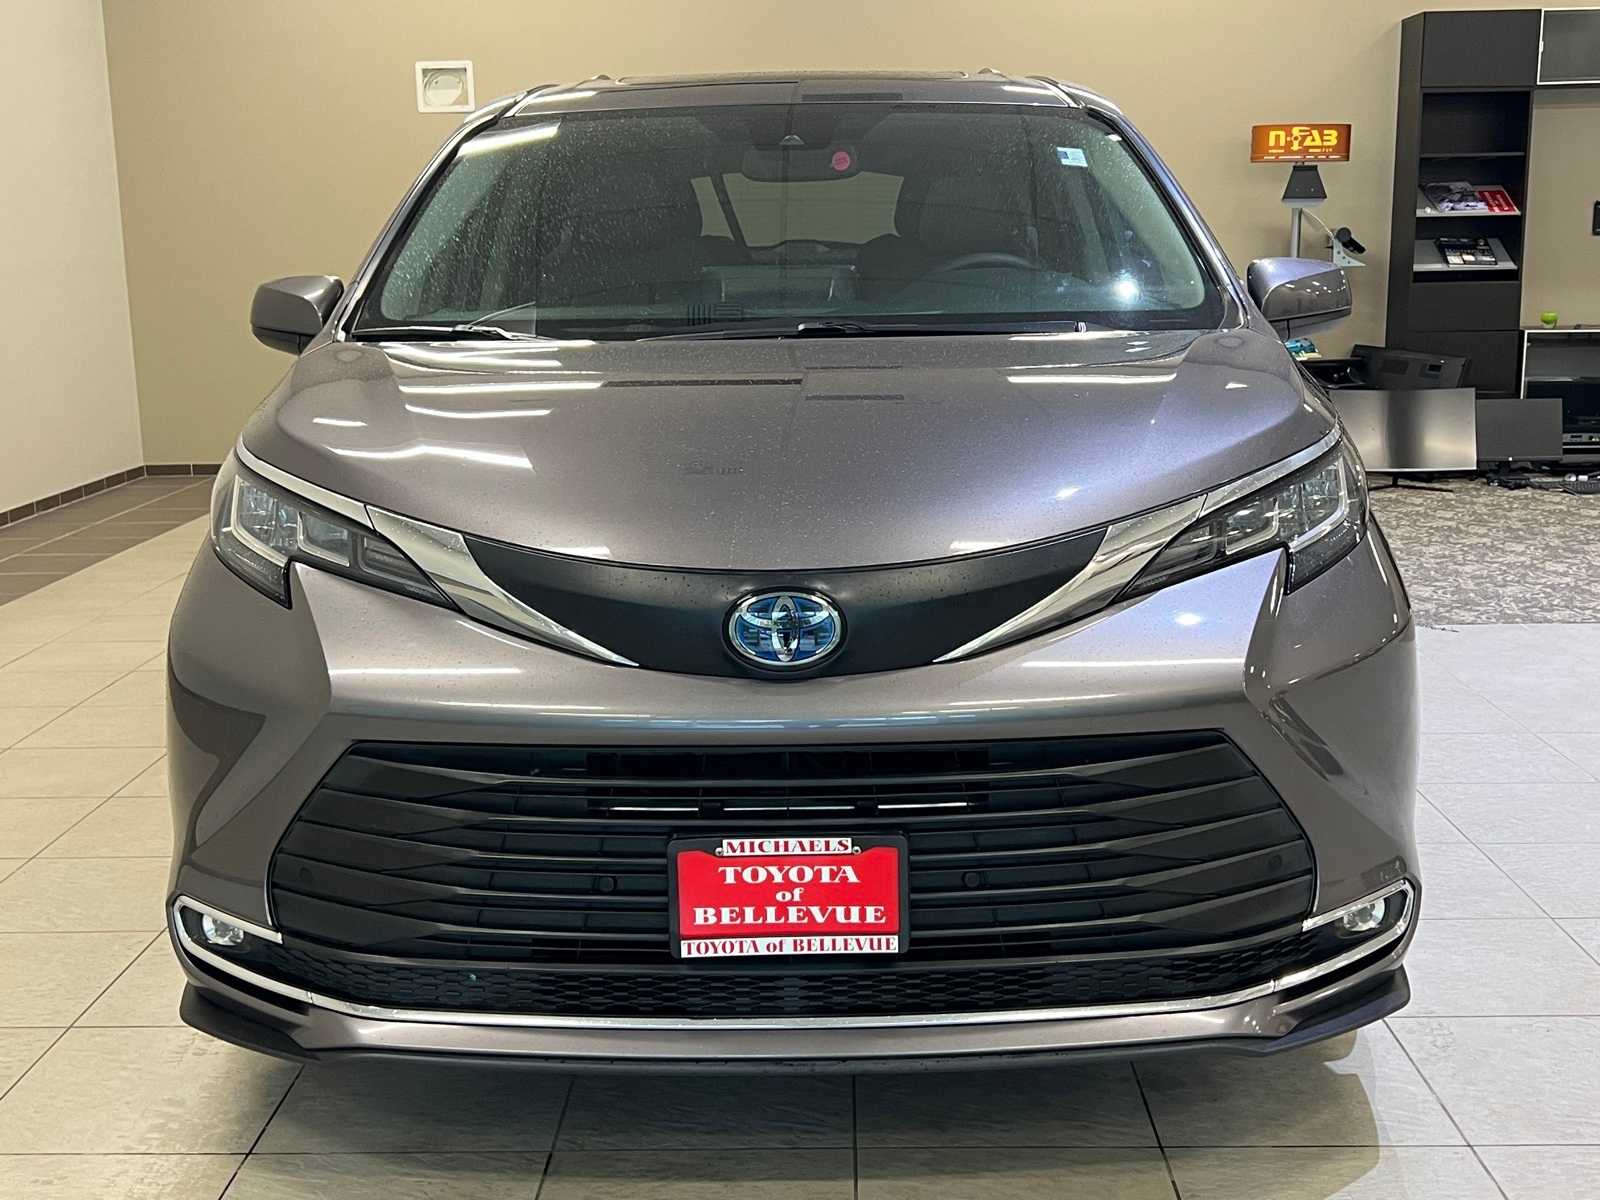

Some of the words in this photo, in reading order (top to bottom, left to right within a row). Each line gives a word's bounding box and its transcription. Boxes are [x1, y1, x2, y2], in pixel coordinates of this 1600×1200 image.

[726, 840, 849, 853] MICHAELS
[718, 866, 860, 884] TOYOTA
[775, 888, 804, 902] of
[693, 906, 886, 925] BELLEVUE
[683, 940, 760, 955] TOYOTA
[766, 940, 786, 953] of
[793, 936, 896, 952] BELLEVUE
